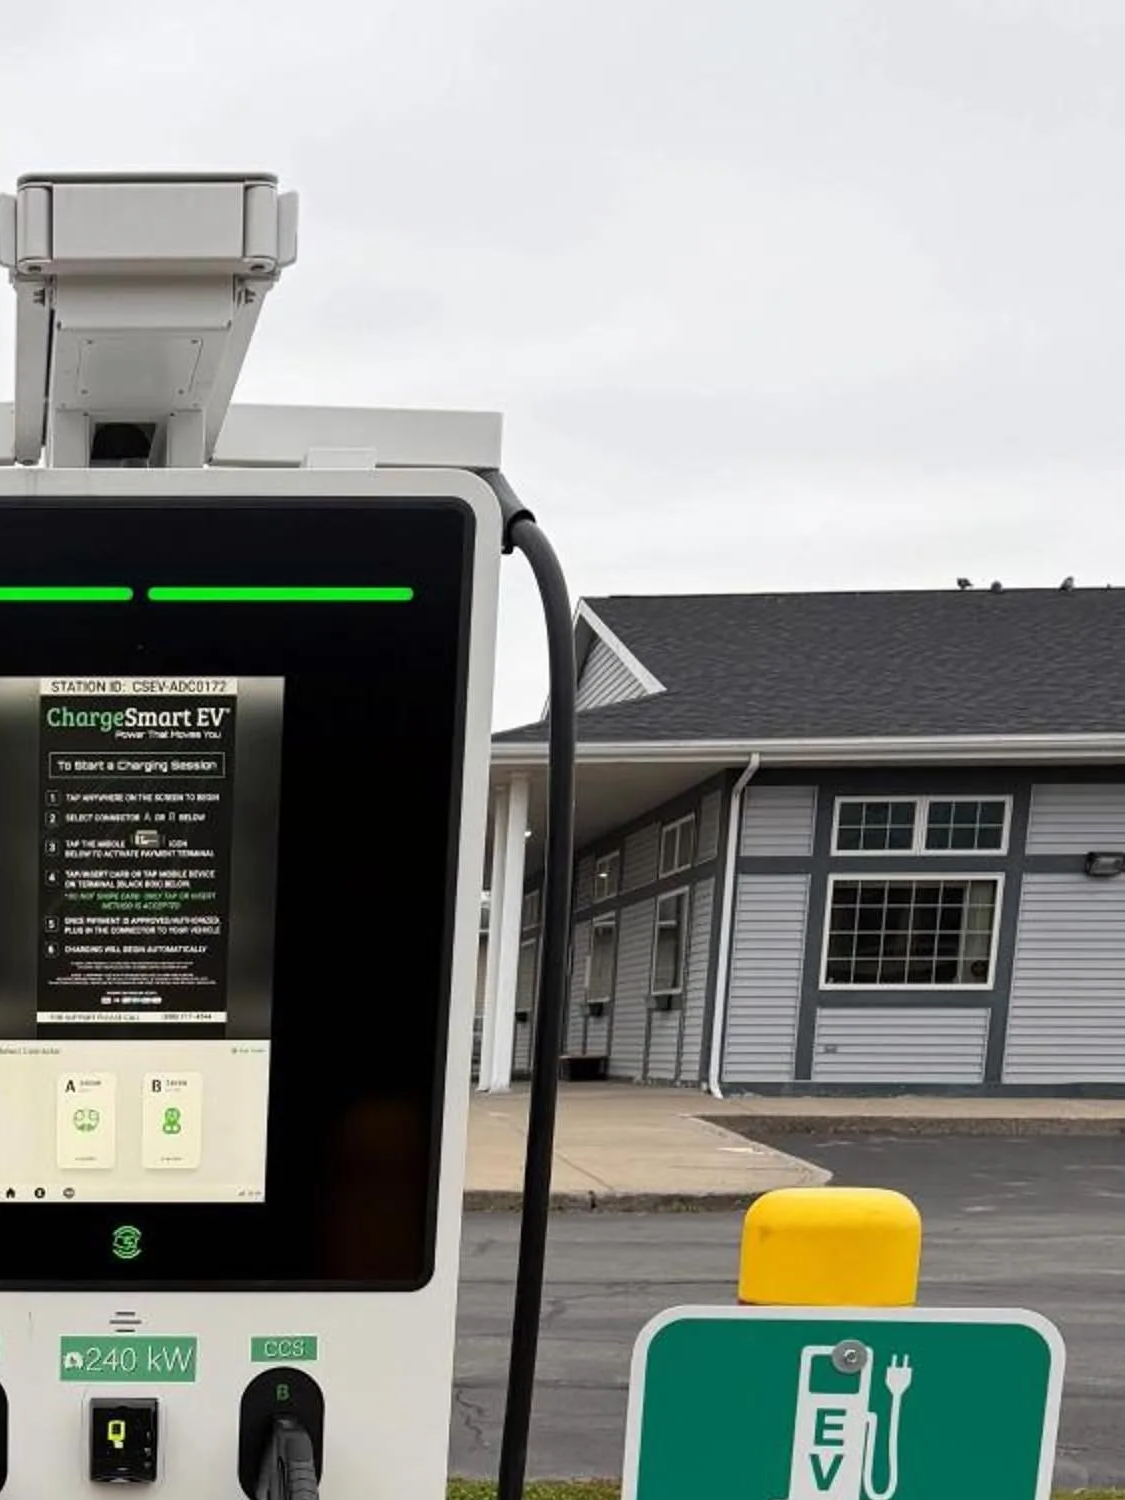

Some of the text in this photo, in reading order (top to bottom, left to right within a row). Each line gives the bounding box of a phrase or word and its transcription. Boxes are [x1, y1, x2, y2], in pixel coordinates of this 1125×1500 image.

[51, 681, 106, 693] STATION
[46, 706, 192, 732] ChargeSmart
[57, 760, 218, 772] To Start a Charging Session
[65, 1079, 76, 1093] A
[151, 1079, 162, 1093] B
[263, 1340, 306, 1357] CCS
[86, 1347, 194, 1372] 240 kW
[277, 1384, 289, 1401] B
